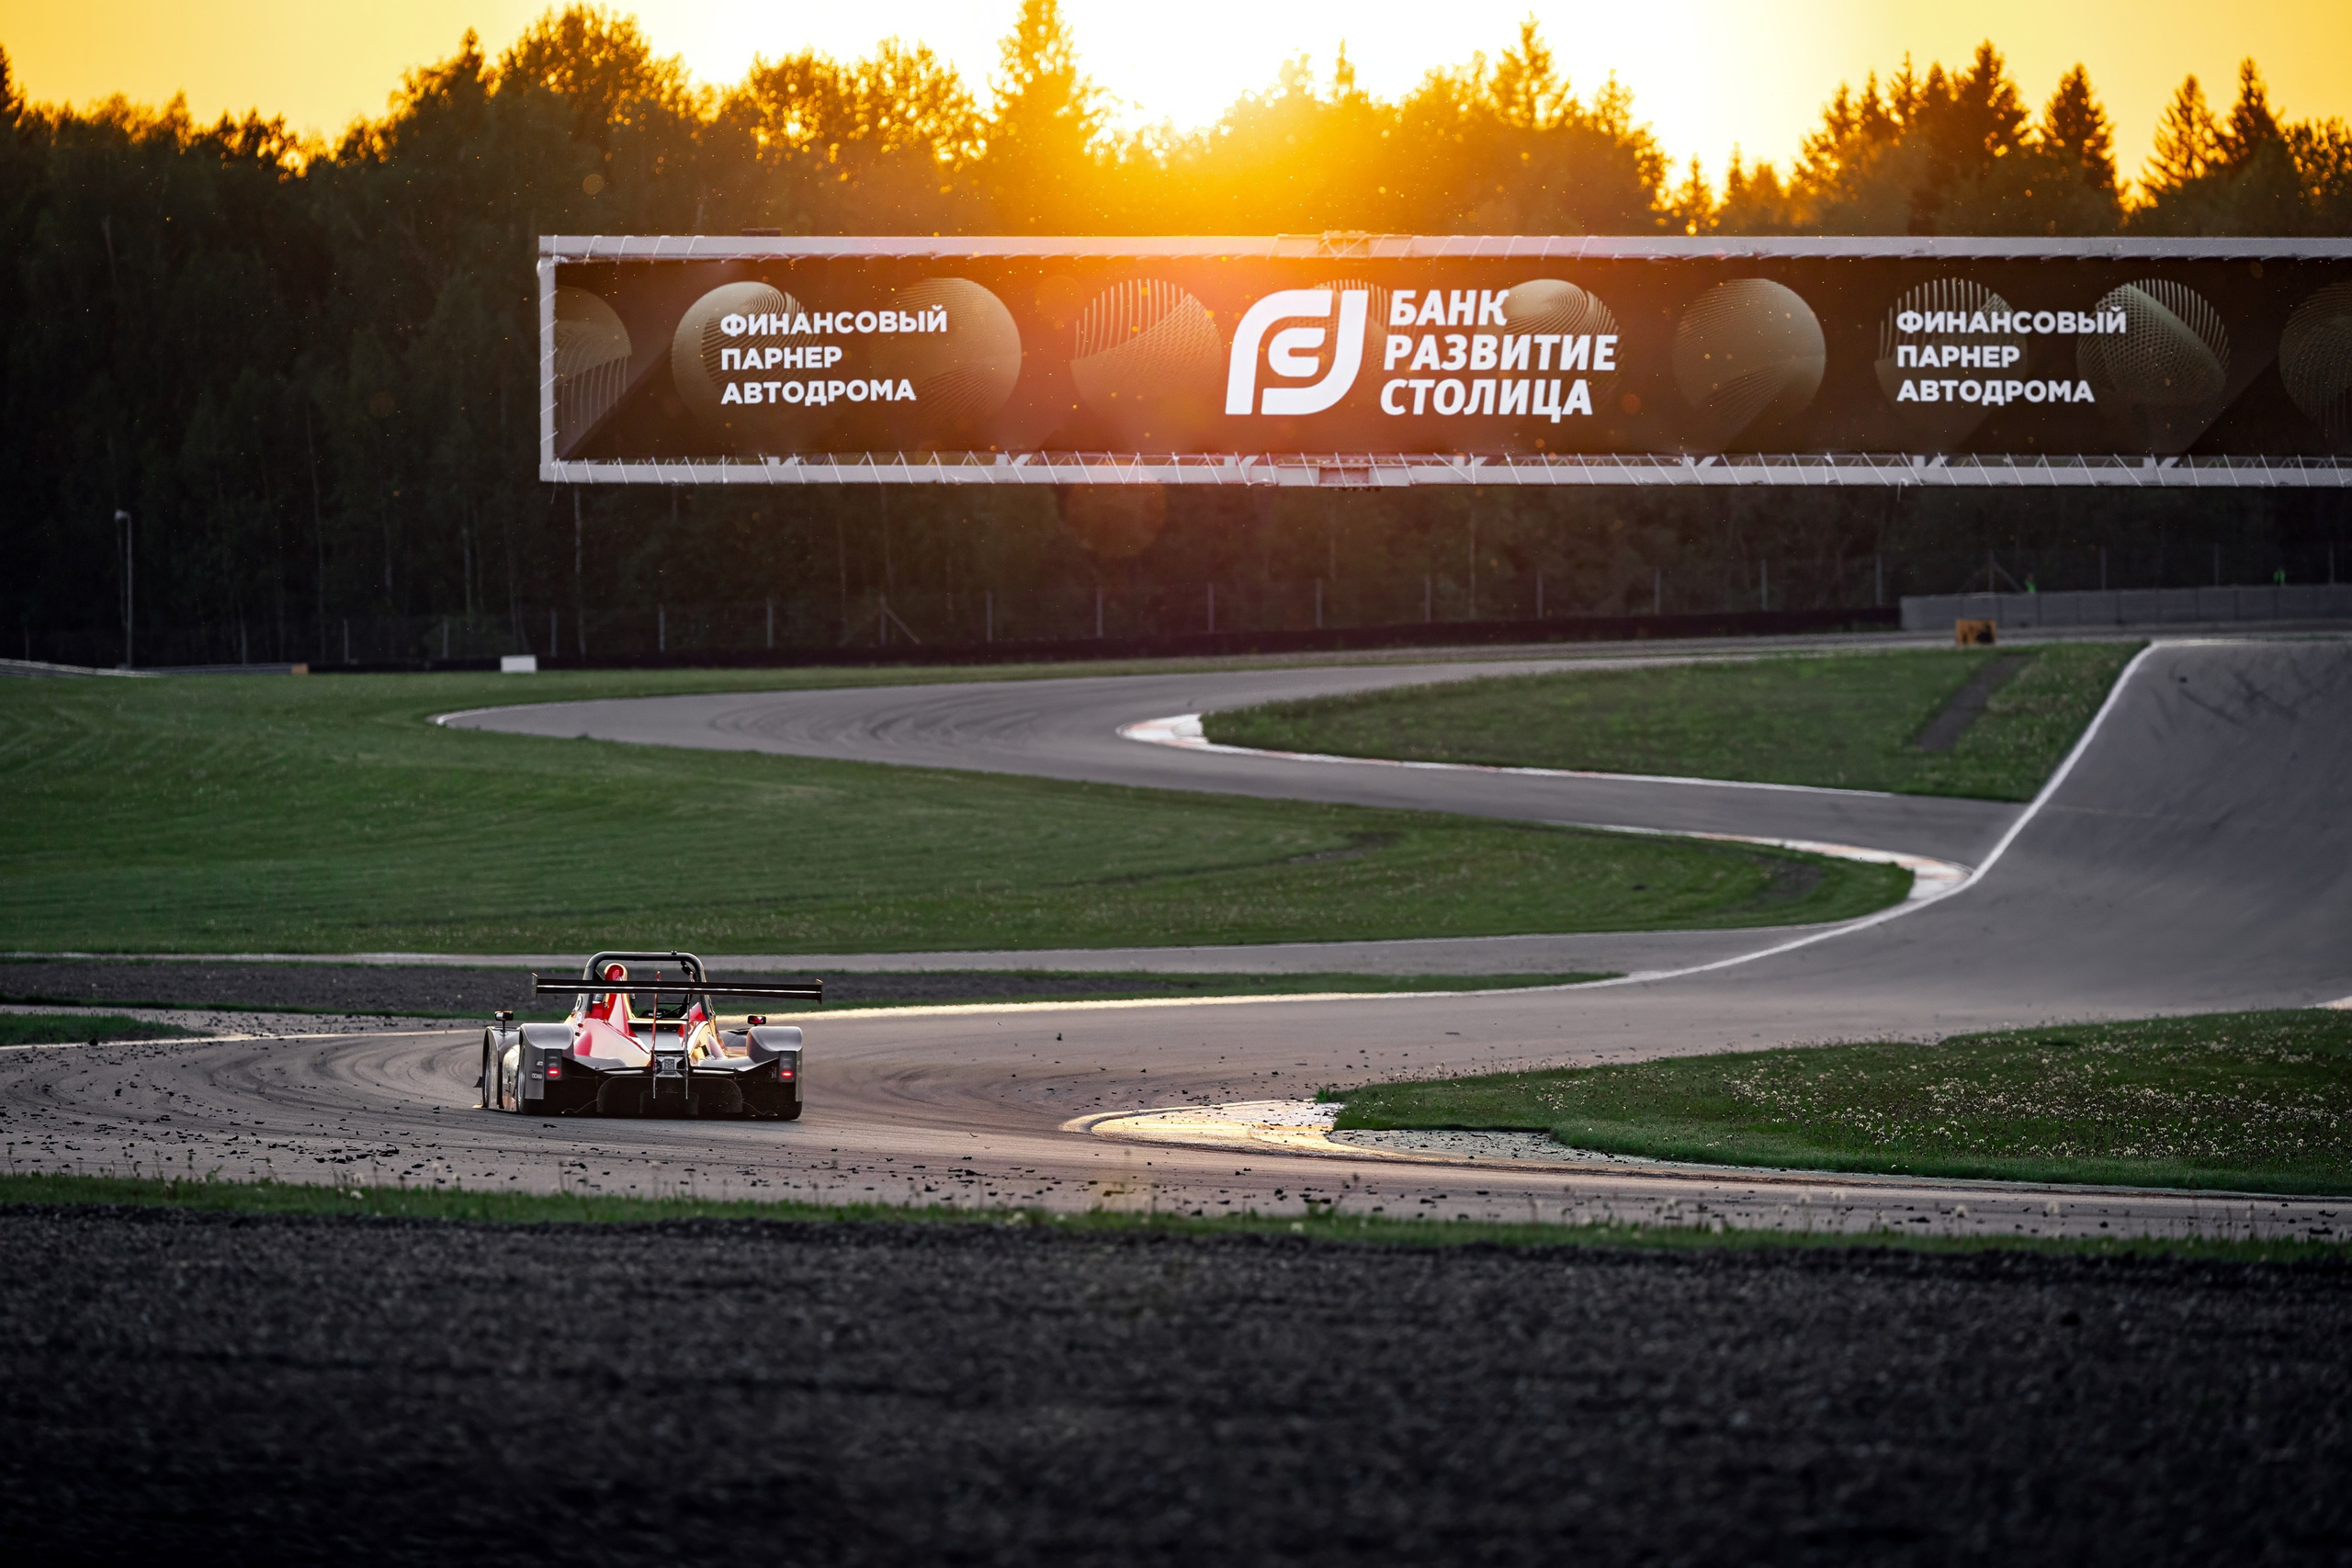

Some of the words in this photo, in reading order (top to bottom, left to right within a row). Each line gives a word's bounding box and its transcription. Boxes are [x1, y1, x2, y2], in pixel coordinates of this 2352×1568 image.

[719, 305, 947, 337] ФИНАНСОВЫЙ
[1388, 288, 1510, 326] БАНК
[1895, 305, 2127, 334] ФИНАНСОВЫЙ
[720, 345, 843, 371] ПАРНЕР
[1383, 333, 1618, 371] РАЗВИТИЕ
[1896, 344, 2020, 368] ПАРНЕР
[720, 378, 917, 407] АВТОДРОМА
[1380, 378, 1593, 423] СТОЛИЦА
[1895, 379, 2096, 407] АВТОДРОМА
